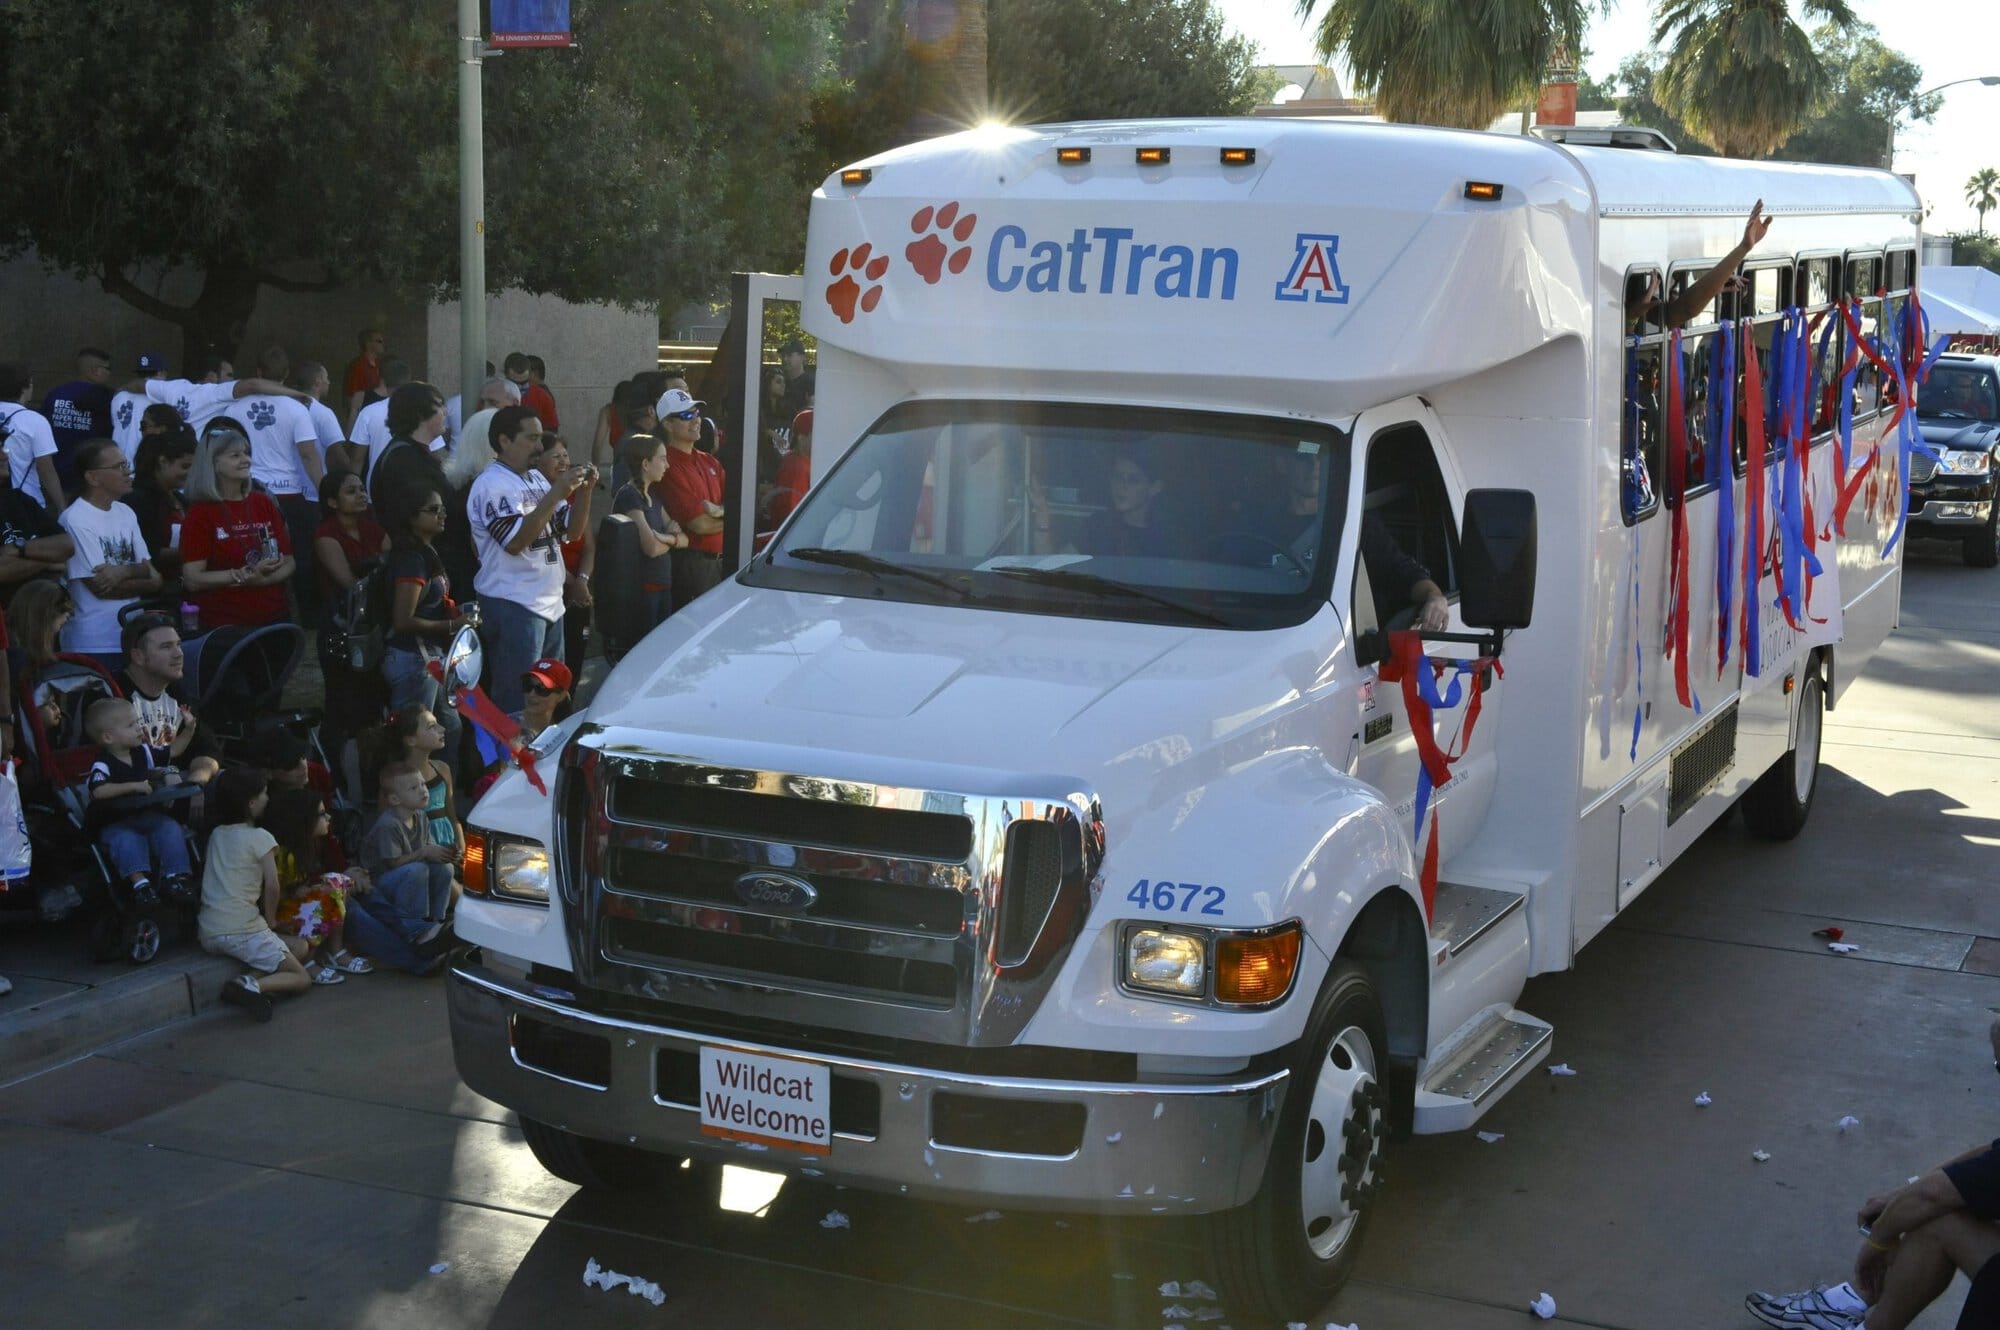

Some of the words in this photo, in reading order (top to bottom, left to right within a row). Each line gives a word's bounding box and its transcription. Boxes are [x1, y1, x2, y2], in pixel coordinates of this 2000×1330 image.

[986, 224, 1240, 300] CatTran
[1275, 233, 1350, 304] A
[485, 496, 513, 520] 44
[1127, 879, 1226, 916] 4672
[716, 1059, 813, 1102] Wildcat
[705, 1091, 825, 1139] Welcome
